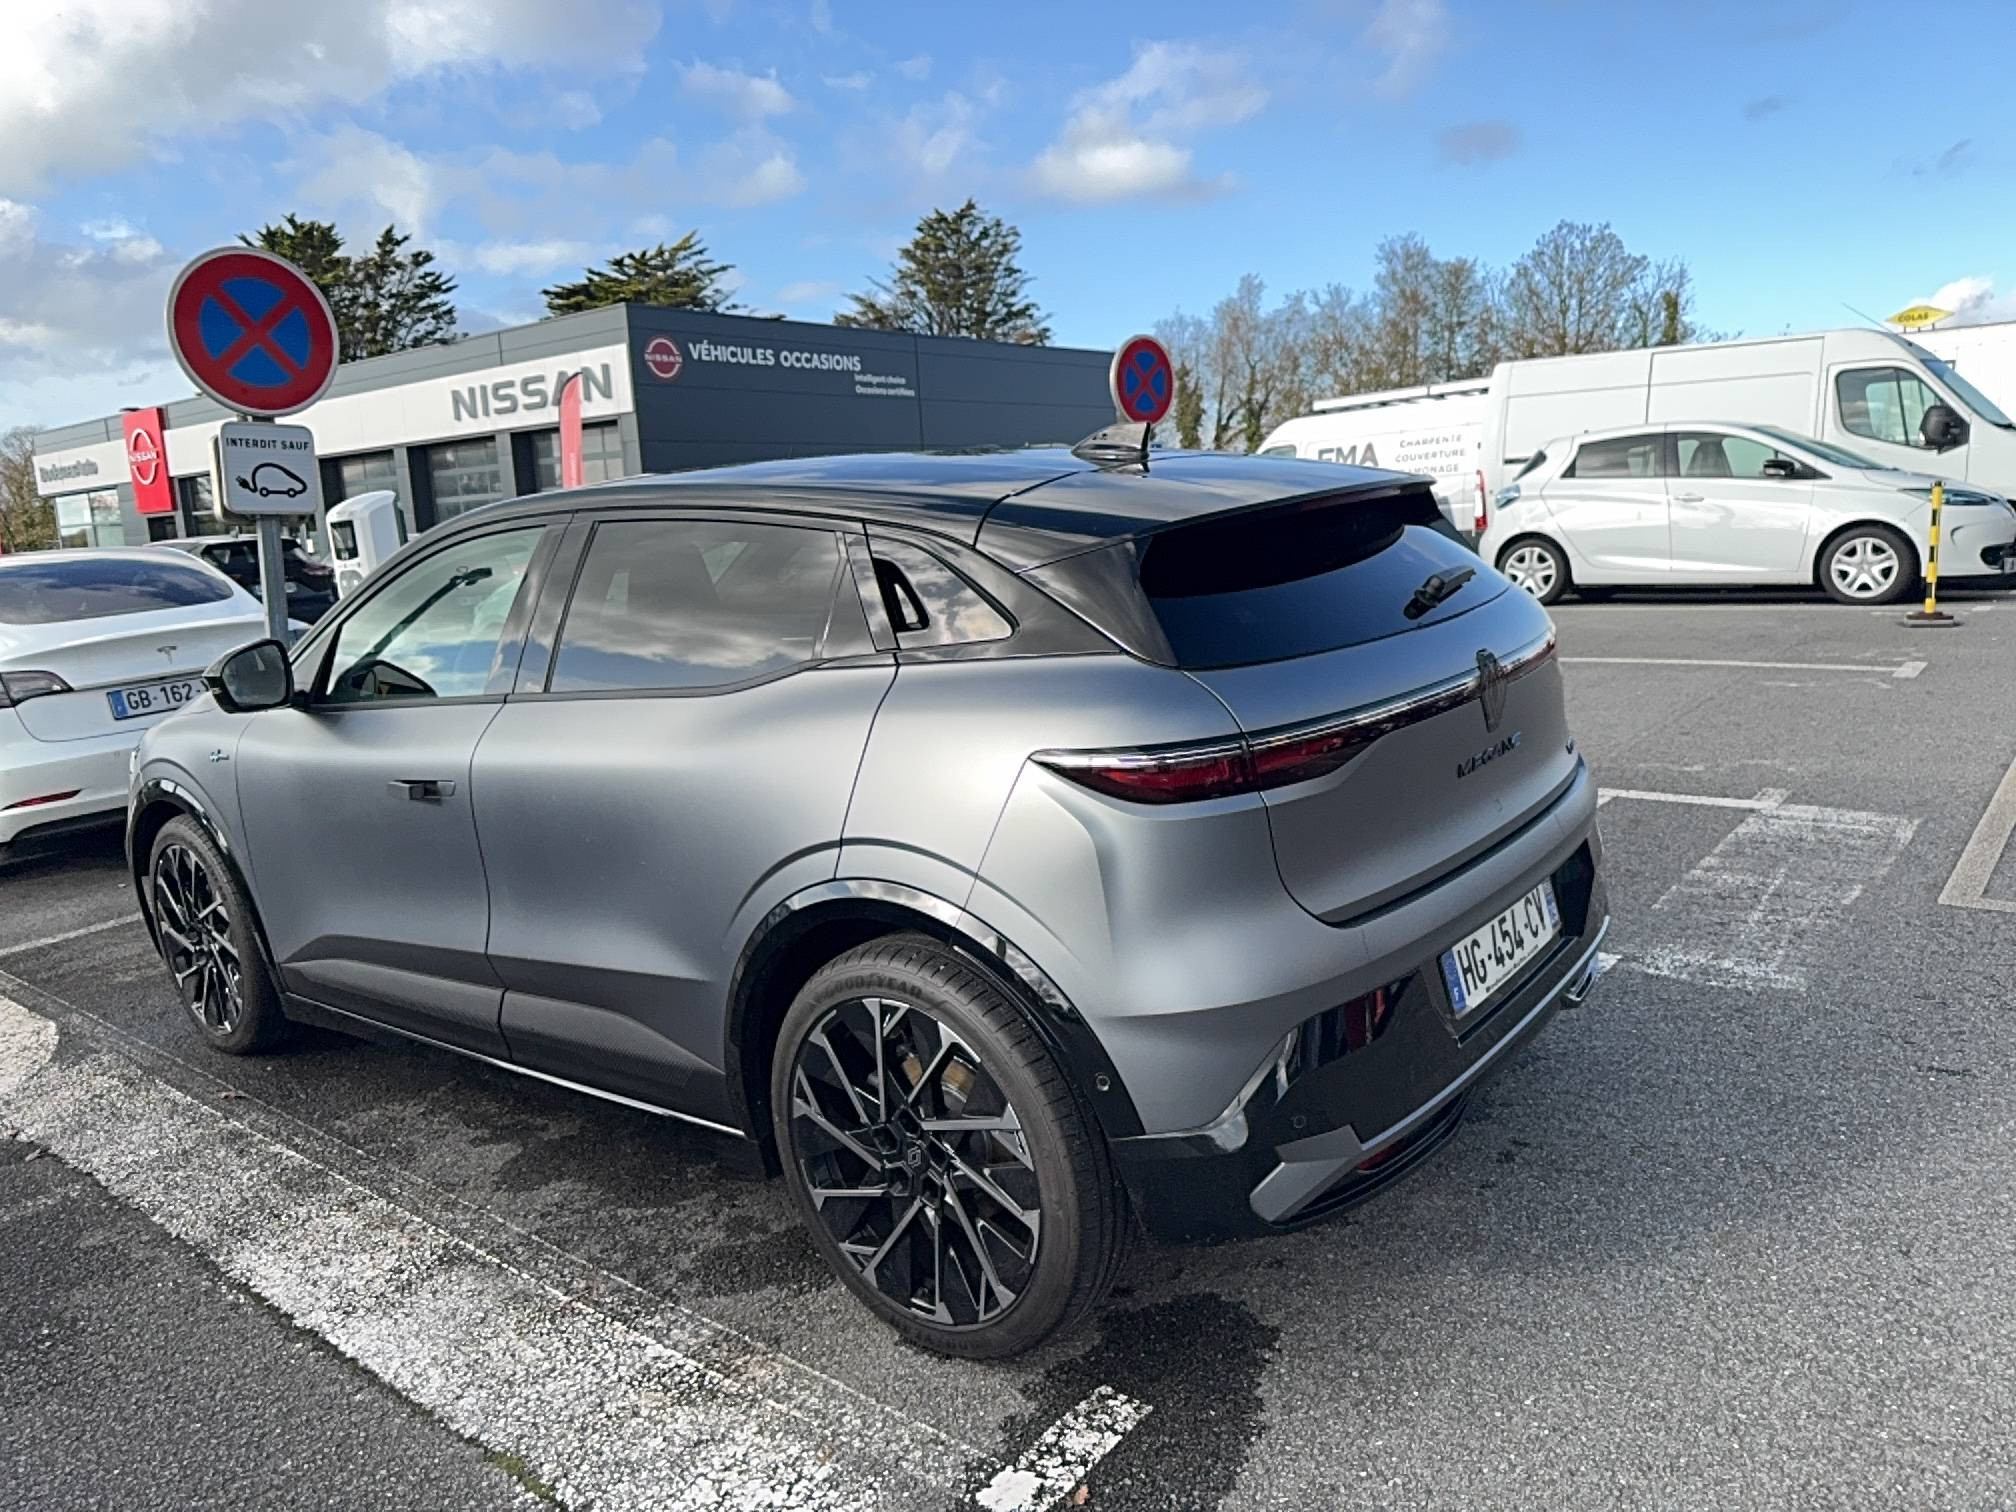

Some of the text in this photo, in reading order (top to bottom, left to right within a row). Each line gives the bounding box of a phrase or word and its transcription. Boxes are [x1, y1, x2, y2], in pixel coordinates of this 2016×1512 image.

[643, 353, 683, 364] NISSAN
[688, 339, 862, 372] VÉHICULES OCCASIONS
[225, 437, 310, 451] INTERDIT SAUF
[1399, 434, 1463, 448] CHARPENTE
[1394, 447, 1466, 463] COUVERTURE
[1456, 886, 1547, 997] HG-454-CV
